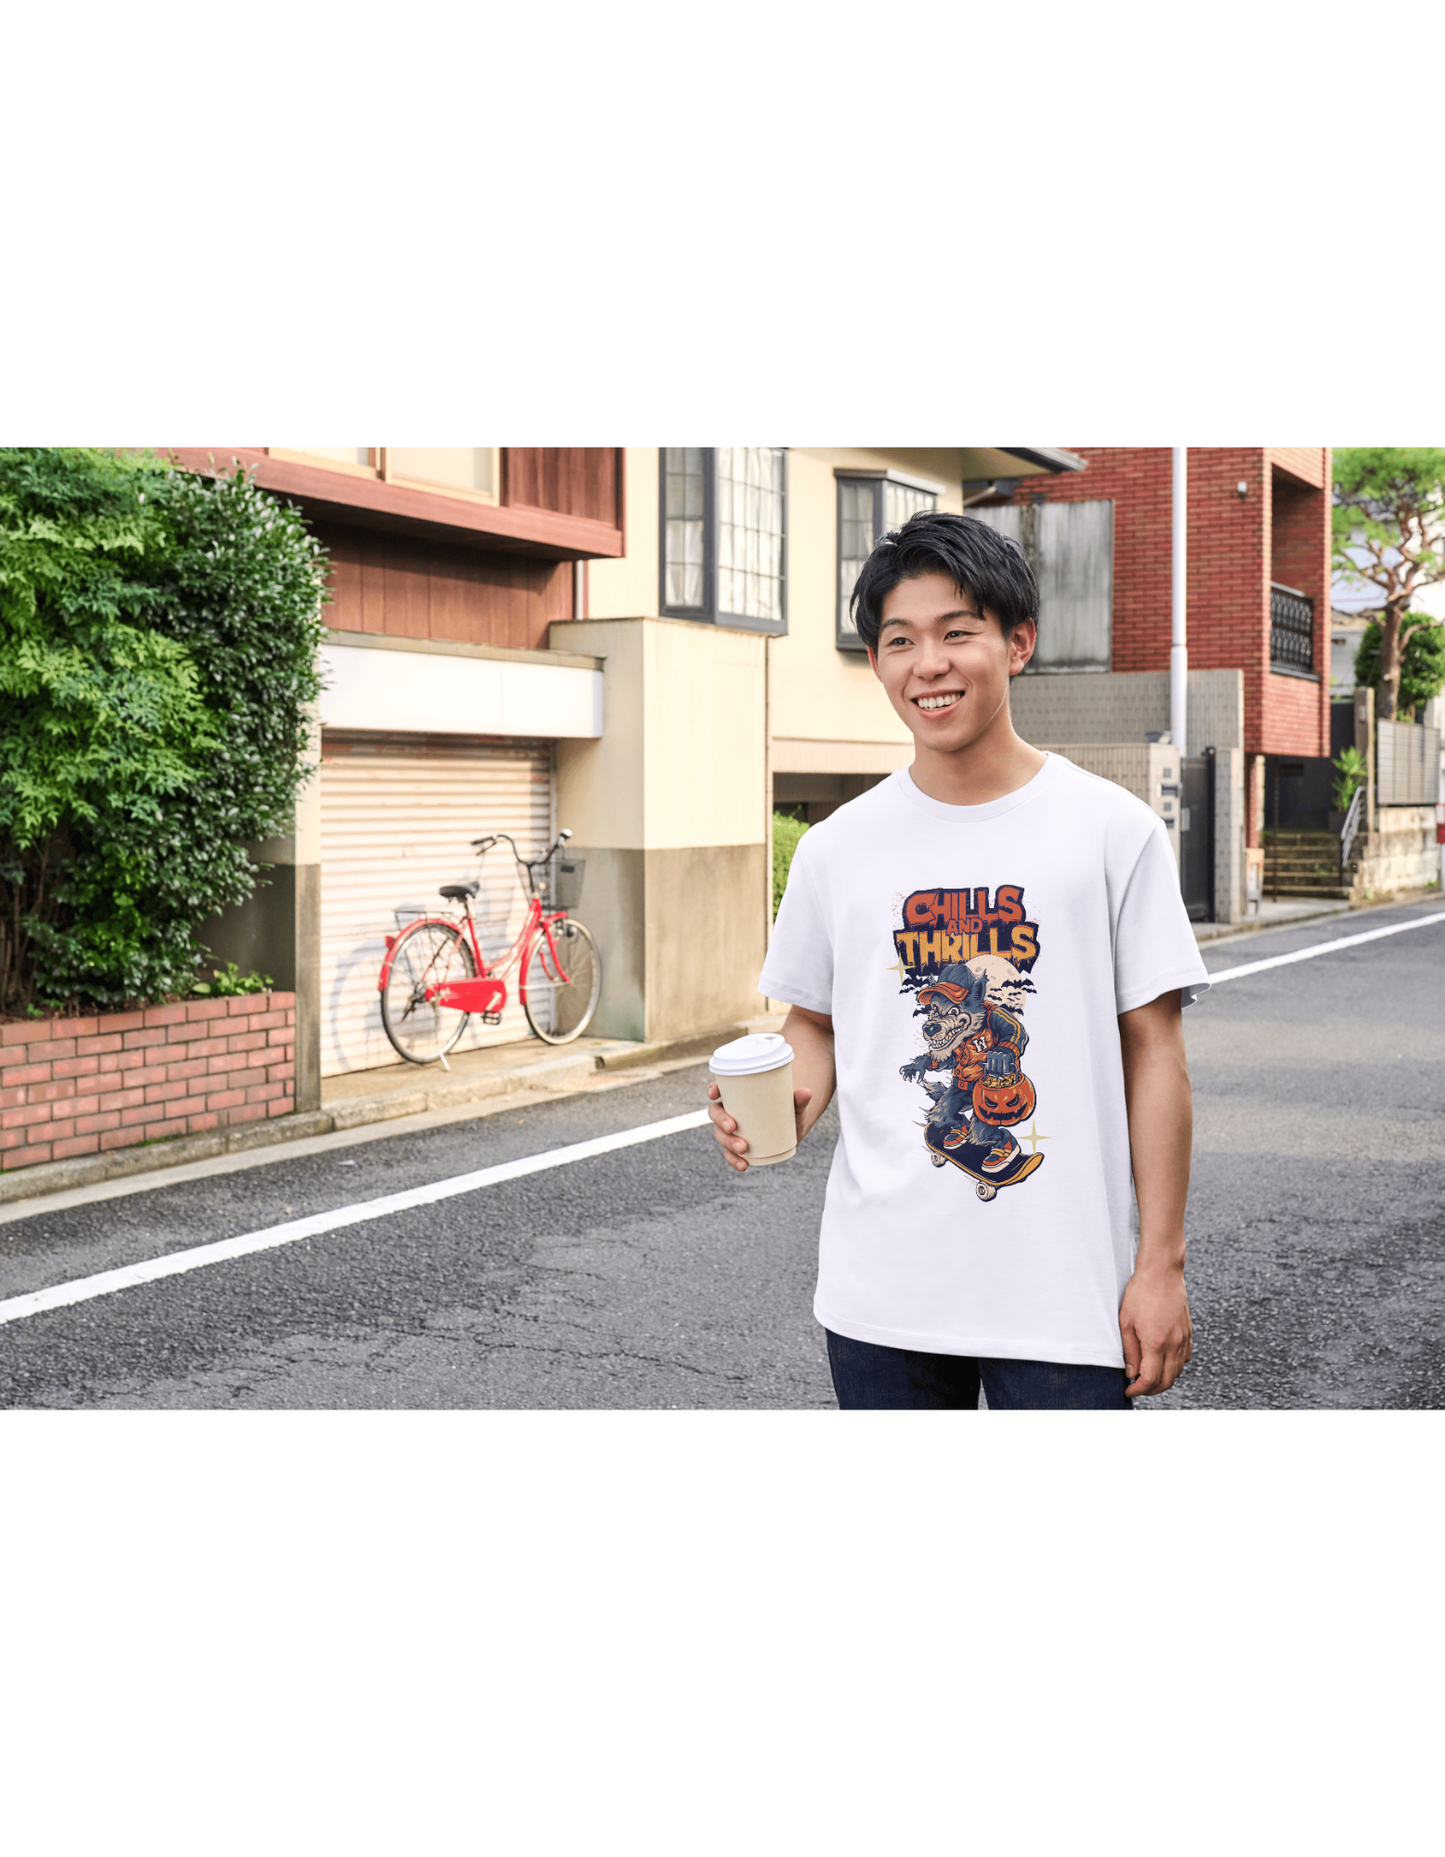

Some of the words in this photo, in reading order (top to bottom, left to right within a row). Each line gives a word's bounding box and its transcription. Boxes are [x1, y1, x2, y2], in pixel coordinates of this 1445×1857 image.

[905, 886, 1023, 925] CHILLS
[946, 918, 983, 935] AND
[896, 924, 1037, 968] THRILLS
[972, 1035, 988, 1053] W
